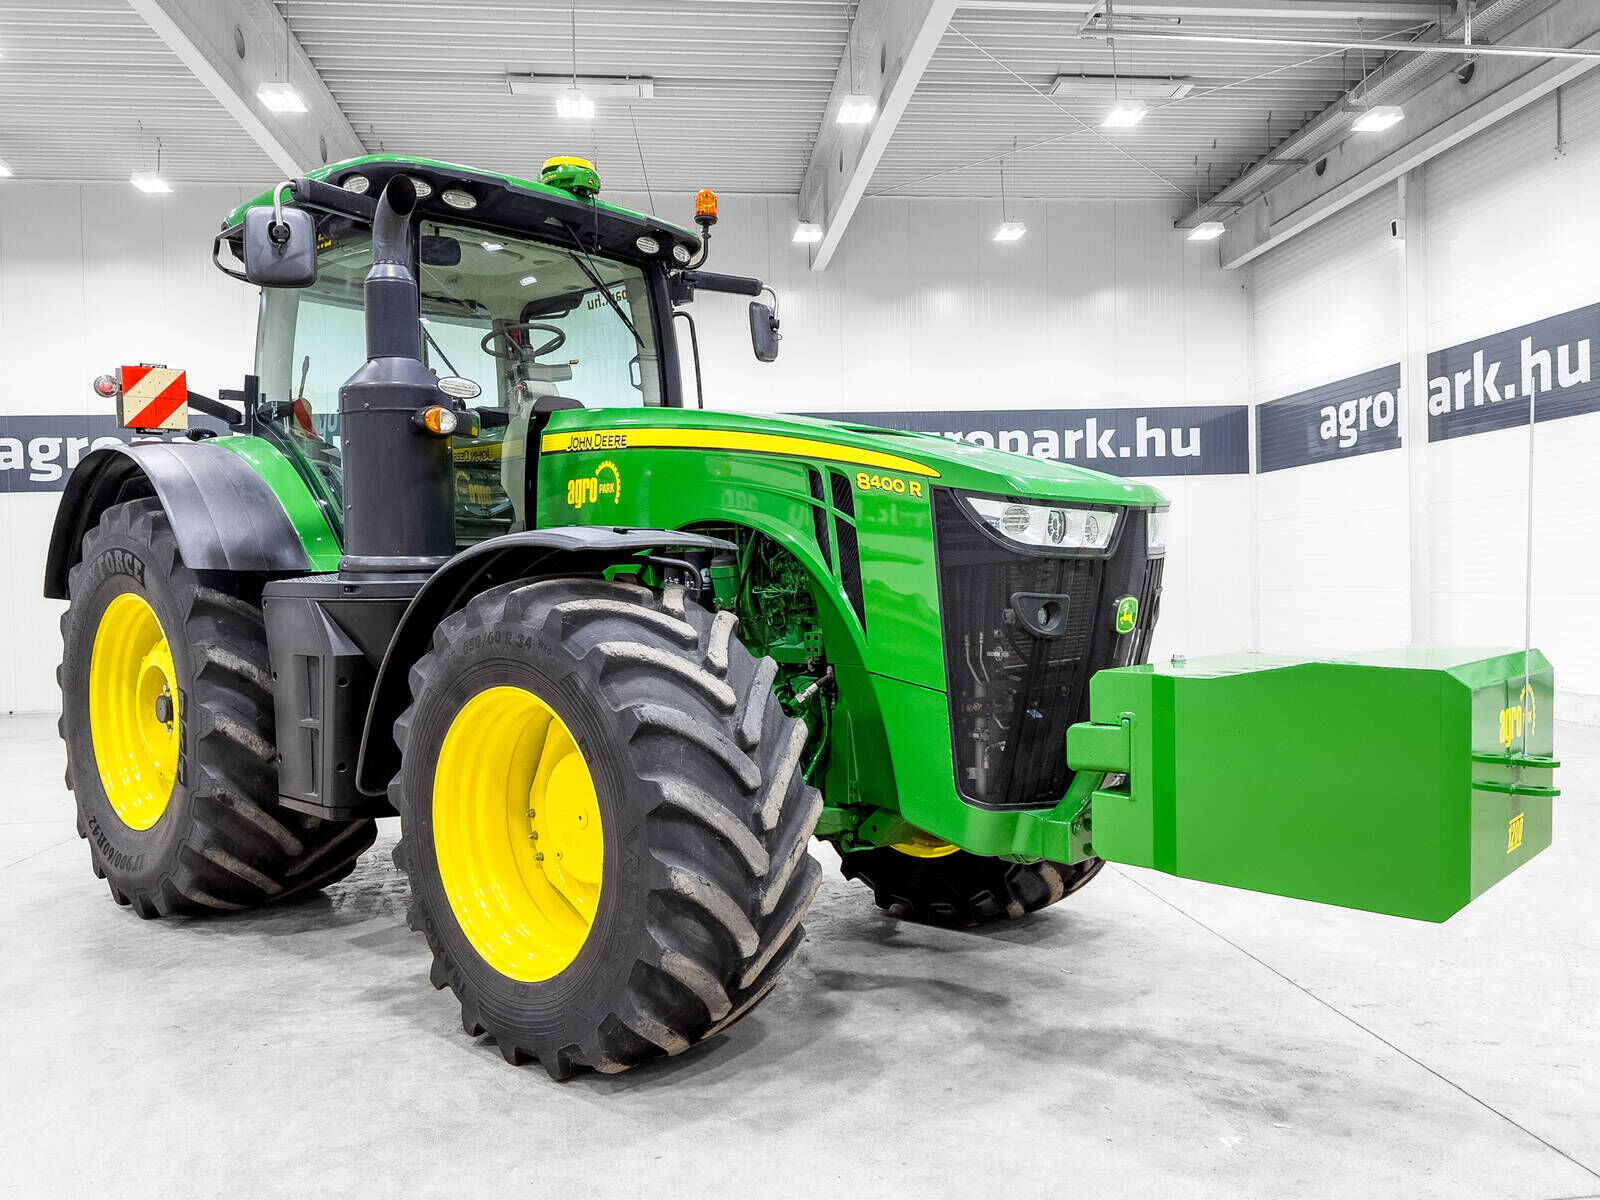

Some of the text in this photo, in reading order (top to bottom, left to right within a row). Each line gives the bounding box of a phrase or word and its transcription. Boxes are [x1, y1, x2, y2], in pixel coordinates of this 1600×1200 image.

[1319, 336, 1592, 449] agroark.hu
[567, 433, 627, 450] JOHN DEERE
[567, 477, 615, 509] agro PARK
[855, 472, 923, 497] 8400 R
[1500, 705, 1522, 749] agro
